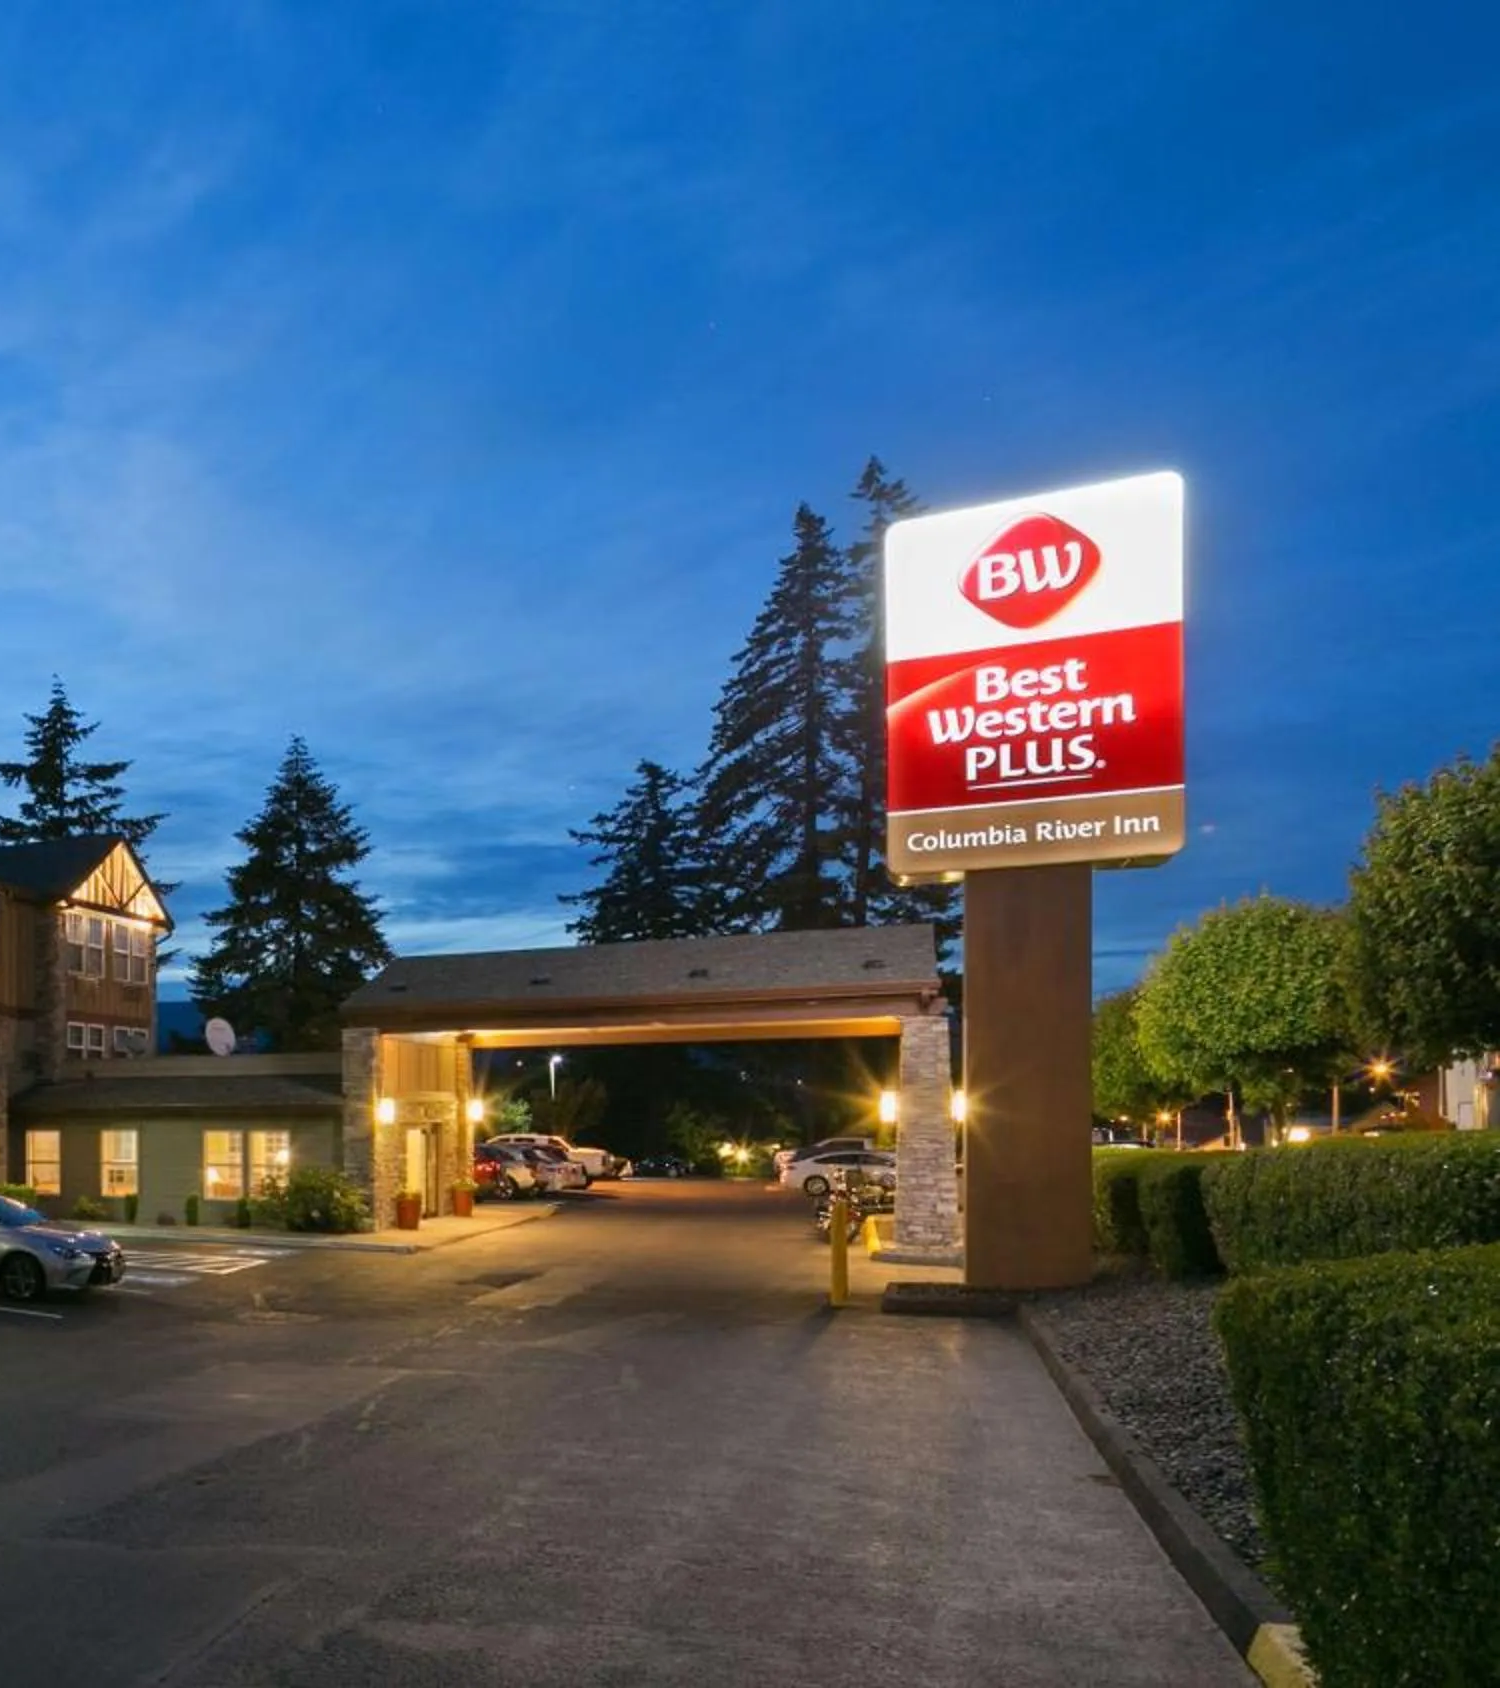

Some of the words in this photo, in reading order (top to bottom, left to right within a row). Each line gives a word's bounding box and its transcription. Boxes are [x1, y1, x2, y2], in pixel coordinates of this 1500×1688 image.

[978, 541, 1081, 599] BW
[976, 658, 1087, 703] Best
[927, 693, 1136, 744] Western
[907, 826, 1027, 852] Columbia
[1035, 819, 1106, 842] River
[1113, 815, 1160, 834] Inn
